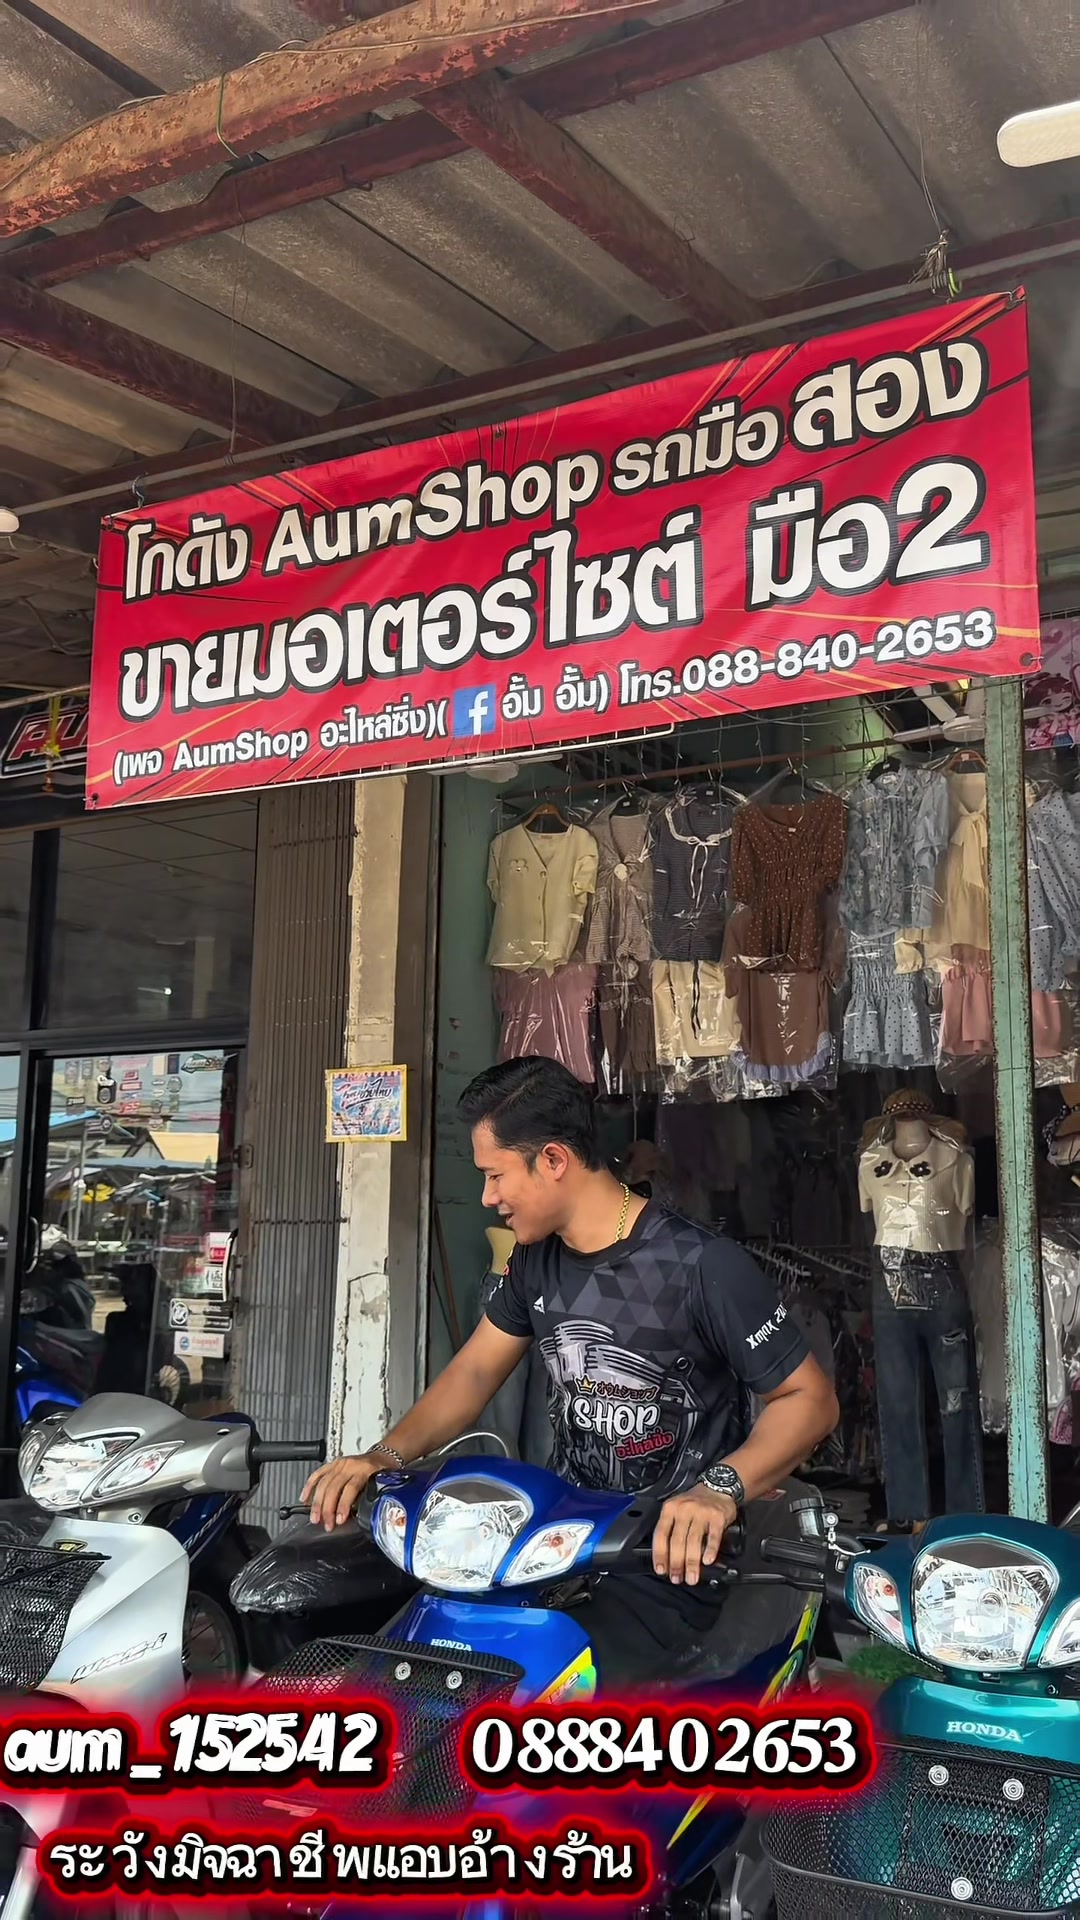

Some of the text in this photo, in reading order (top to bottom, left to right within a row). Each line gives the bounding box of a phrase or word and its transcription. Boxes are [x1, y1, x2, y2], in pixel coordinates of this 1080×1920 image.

[125, 516, 249, 600] โกดัง
[264, 455, 600, 572] AumShop
[792, 341, 983, 448] สอง
[172, 730, 308, 771] AumShop
[502, 675, 541, 719] อั้ม
[556, 666, 609, 712] อั้ม)
[573, 1397, 658, 1442] SHOP
[430, 1638, 473, 1651] HONDA
[946, 1721, 1023, 1743] HONDA
